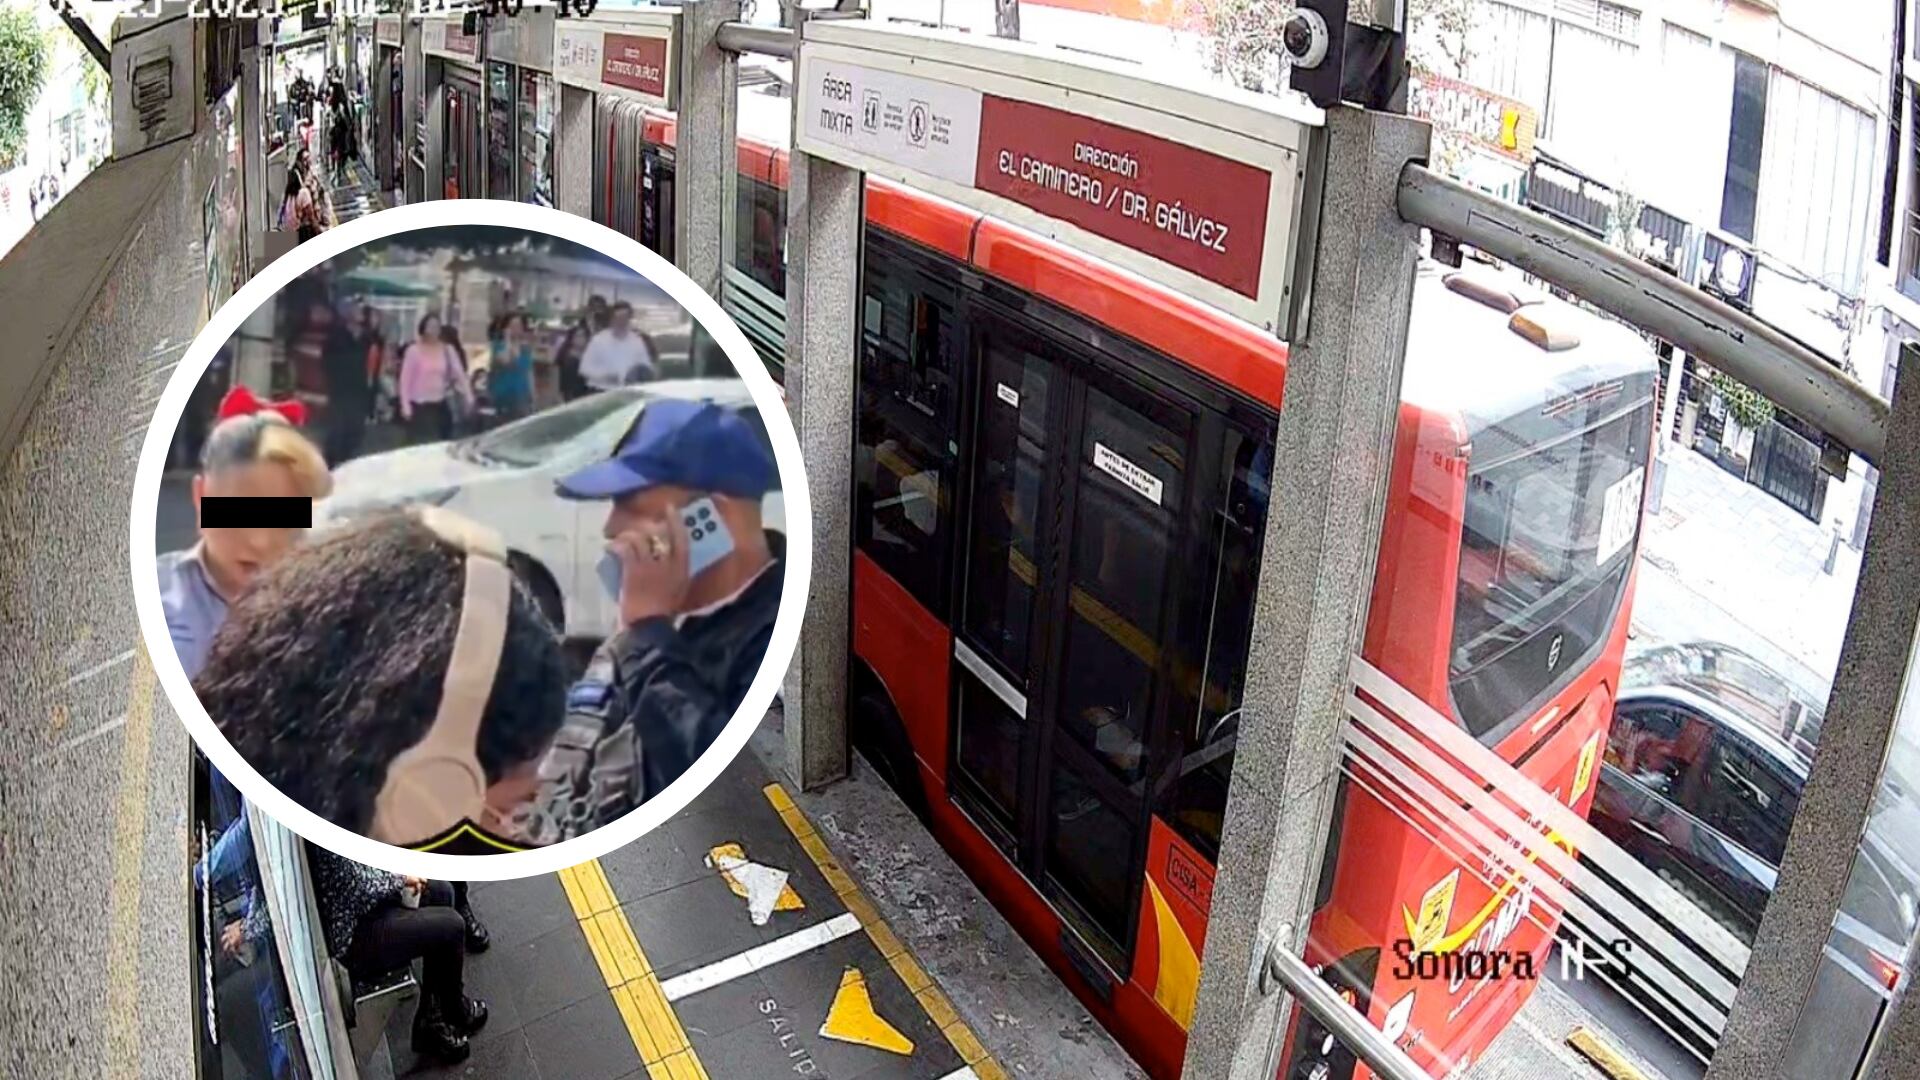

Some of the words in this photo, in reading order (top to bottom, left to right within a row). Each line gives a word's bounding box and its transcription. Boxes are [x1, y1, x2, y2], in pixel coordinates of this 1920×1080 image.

[822, 72, 852, 103] ÁREA
[820, 108, 853, 135] MIXTA
[1075, 142, 1138, 179] DIRECCIÓN
[999, 150, 1017, 177] EL
[1020, 157, 1102, 205] CAMINERO
[1106, 187, 1119, 209] /
[1122, 190, 1151, 223] DR.
[1155, 200, 1229, 253] GÁLVEZ
